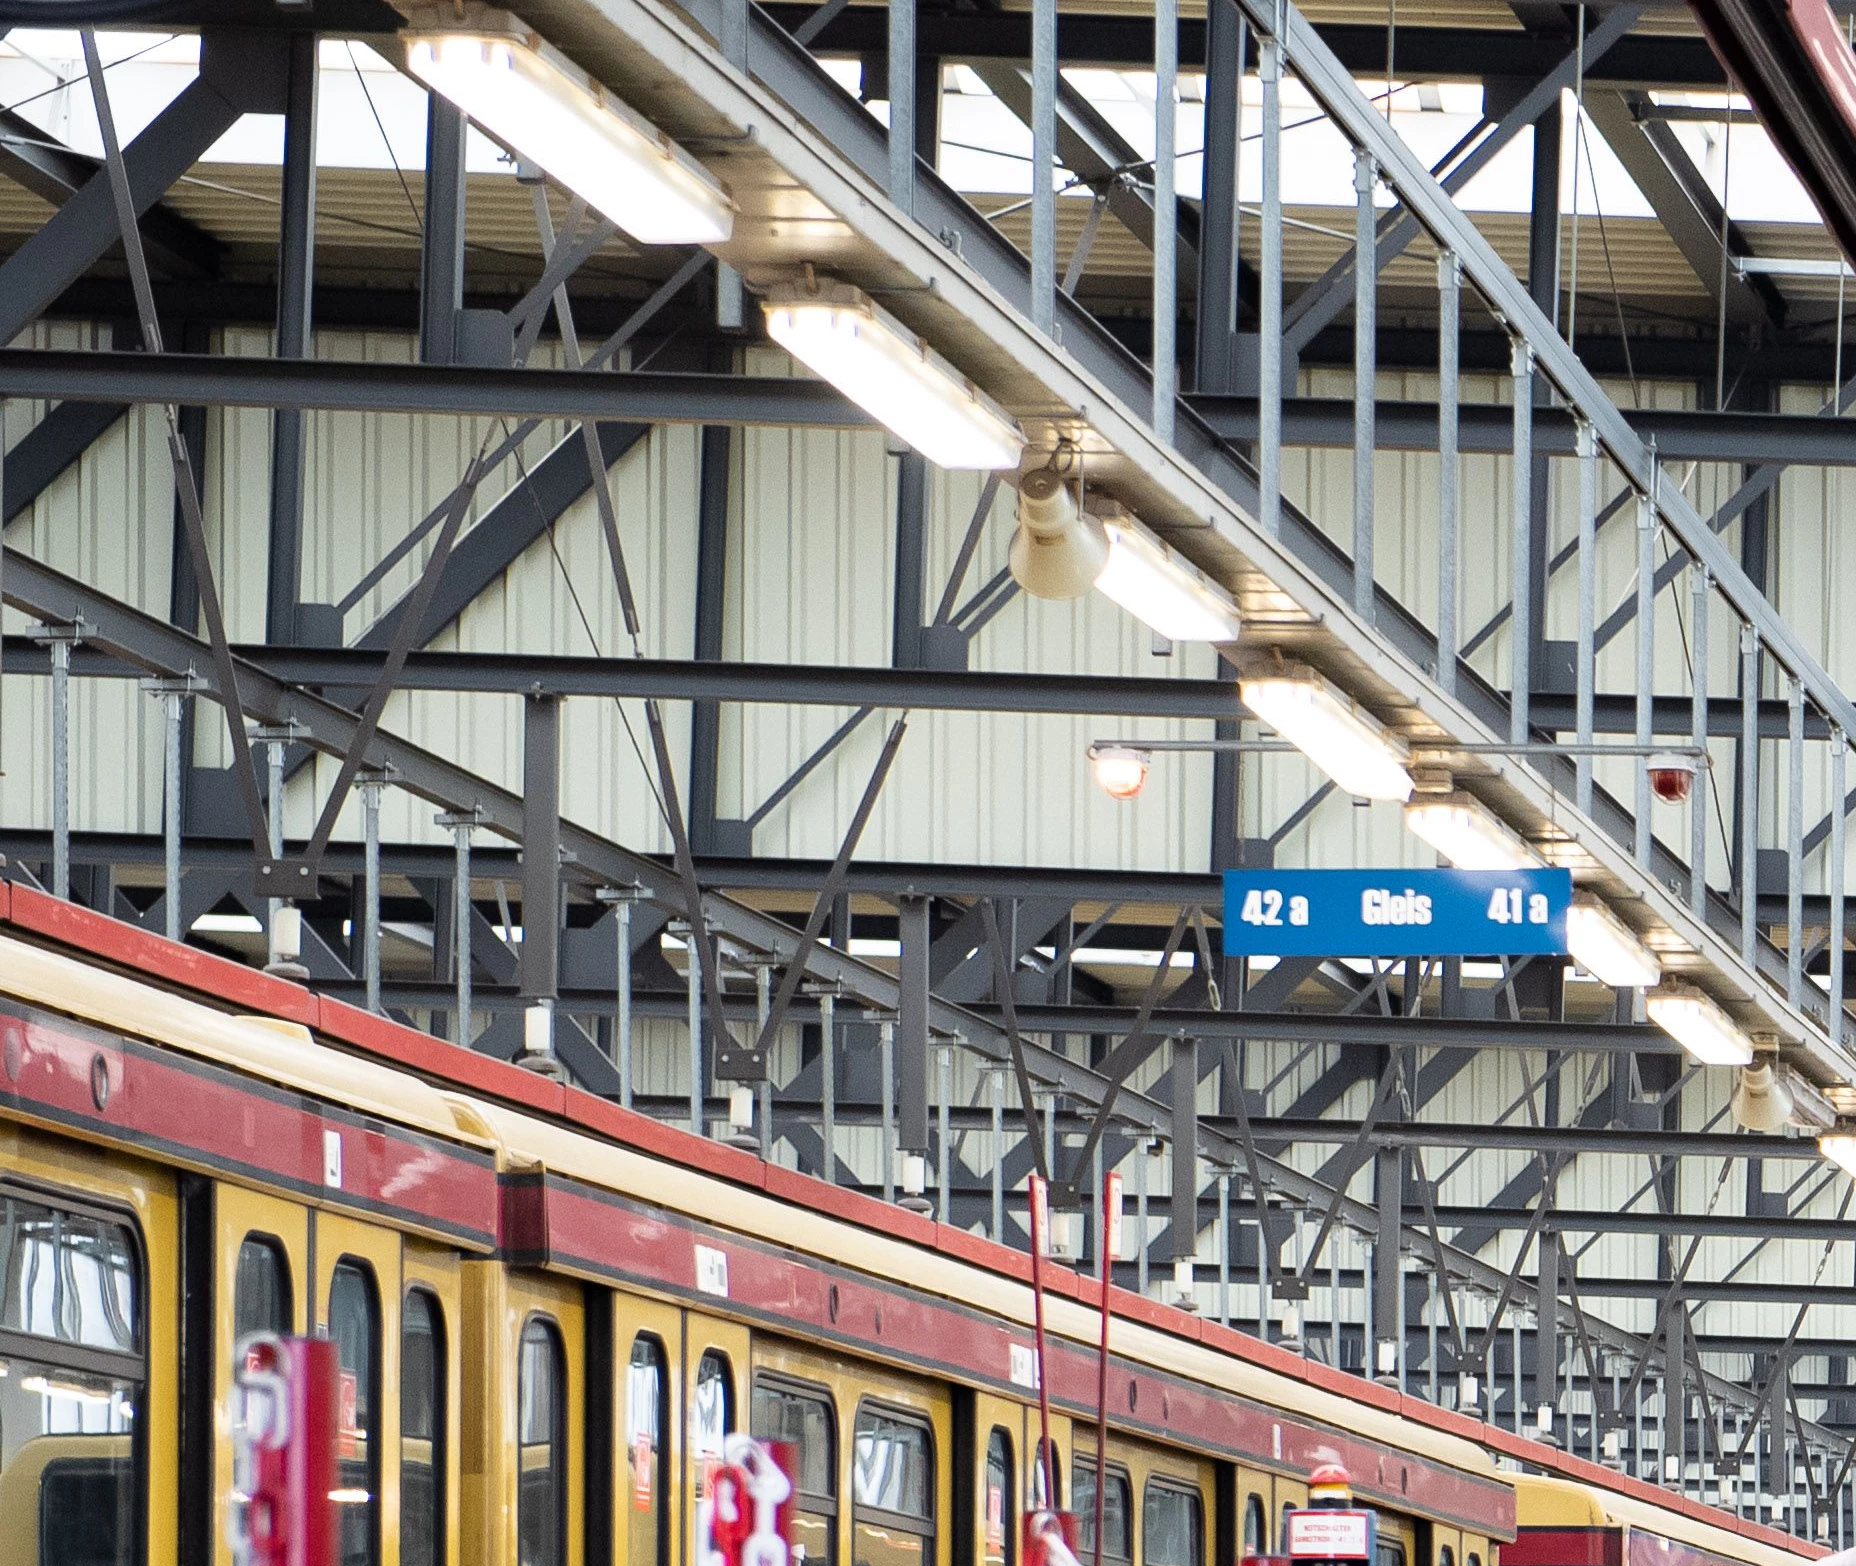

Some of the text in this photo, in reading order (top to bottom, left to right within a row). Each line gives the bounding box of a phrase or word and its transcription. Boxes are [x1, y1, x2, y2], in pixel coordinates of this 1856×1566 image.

[1240, 888, 1549, 927] 42 a Gleis 41 a
